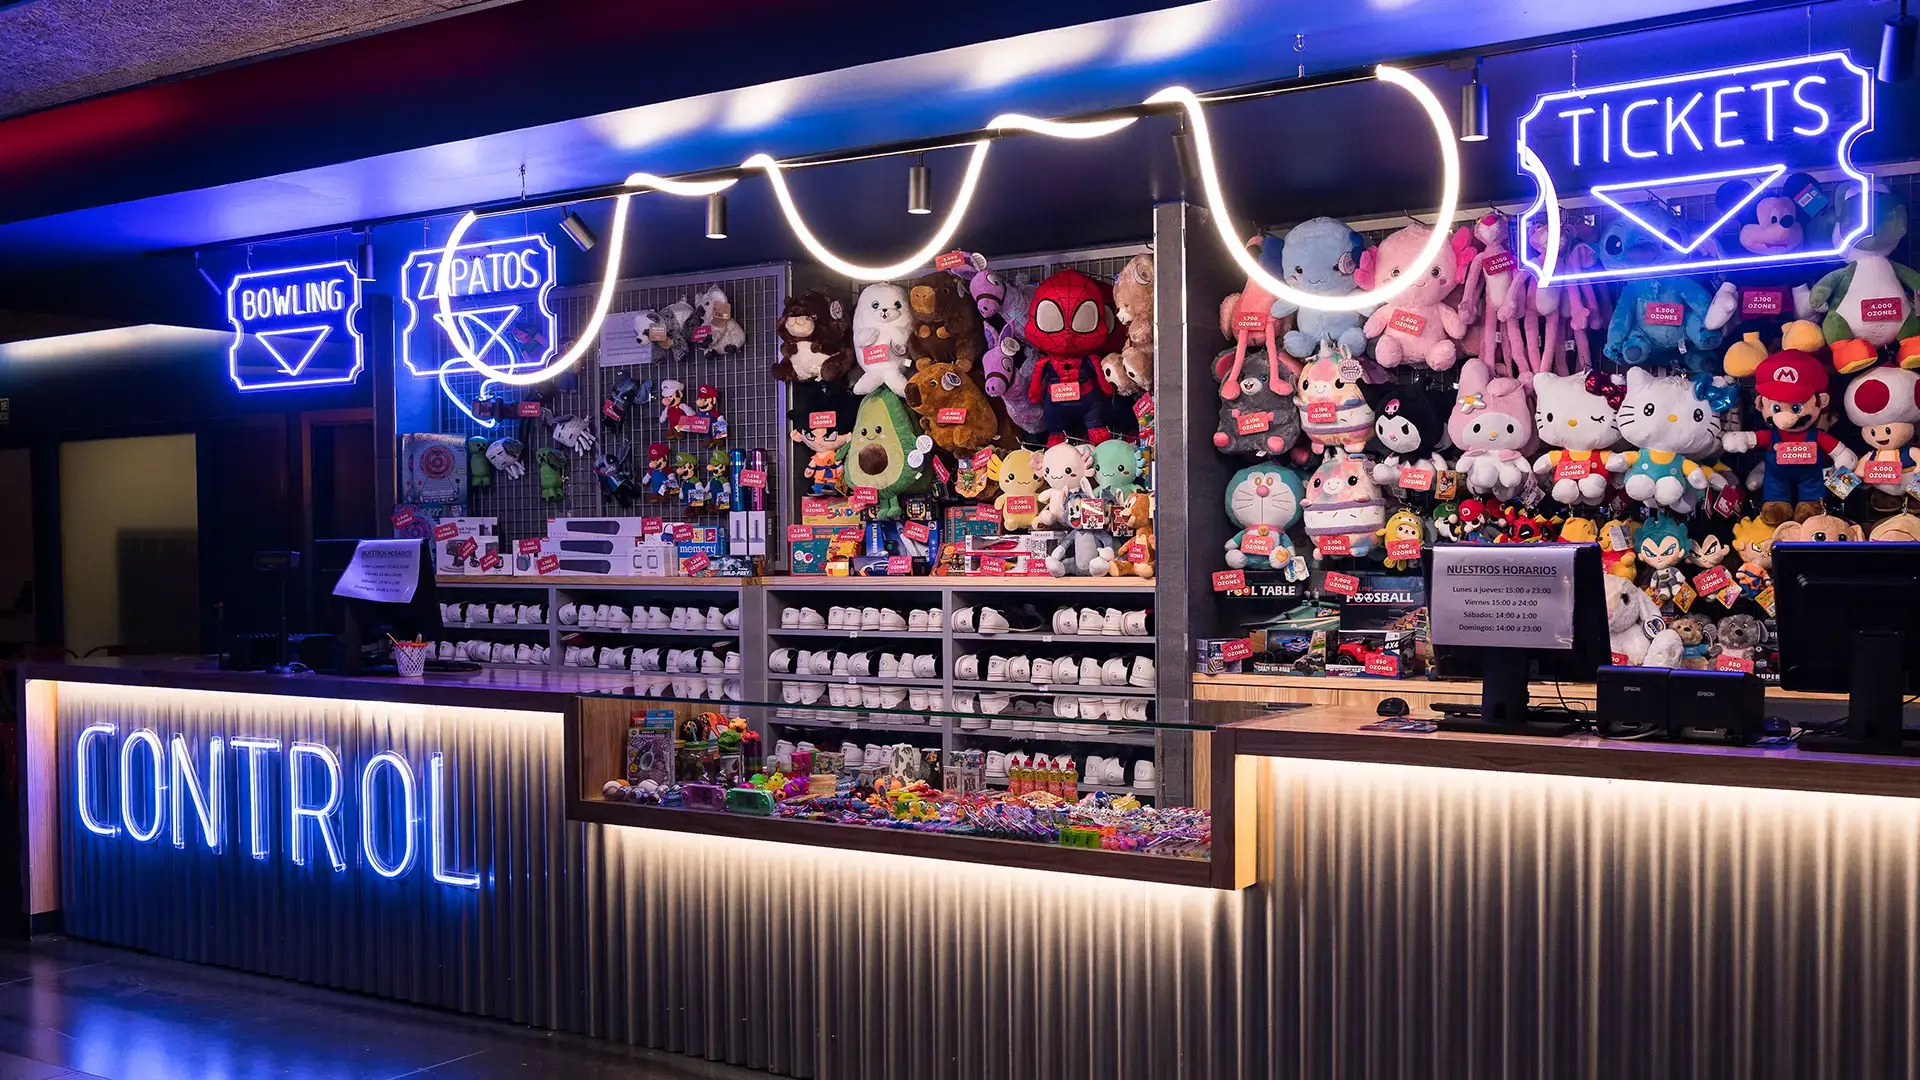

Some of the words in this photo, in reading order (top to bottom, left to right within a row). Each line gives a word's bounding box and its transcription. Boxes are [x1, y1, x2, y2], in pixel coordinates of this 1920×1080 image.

[1558, 76, 1829, 167] TICKETS
[941, 258, 962, 267] OZONES
[1491, 256, 1507, 265] 2.100
[1489, 260, 1514, 271] OZONES
[242, 279, 345, 320] BOWLING
[1395, 320, 1419, 332] OZONES
[1242, 422, 1264, 430] OZONES
[907, 530, 926, 539] OZONES
[680, 544, 717, 554] memory
[983, 565, 1002, 573] OZONES
[1446, 565, 1500, 575] NUESTROS
[1503, 565, 1557, 576] HORARIOS
[1334, 576, 1351, 584] 5.000
[1702, 573, 1717, 583] 1.050
[1329, 581, 1353, 591] OZONES
[1701, 577, 1724, 591] OZONES
[1260, 586, 1296, 596] TABLE
[1479, 586, 1503, 594] jueves:
[1463, 611, 1494, 619] Sábados:
[1458, 624, 1494, 632] Domingos:
[1384, 641, 1399, 649] 4X4
[1227, 649, 1249, 657] OZONES
[1369, 664, 1393, 672] OZONES
[78, 722, 482, 889] CONTROL
